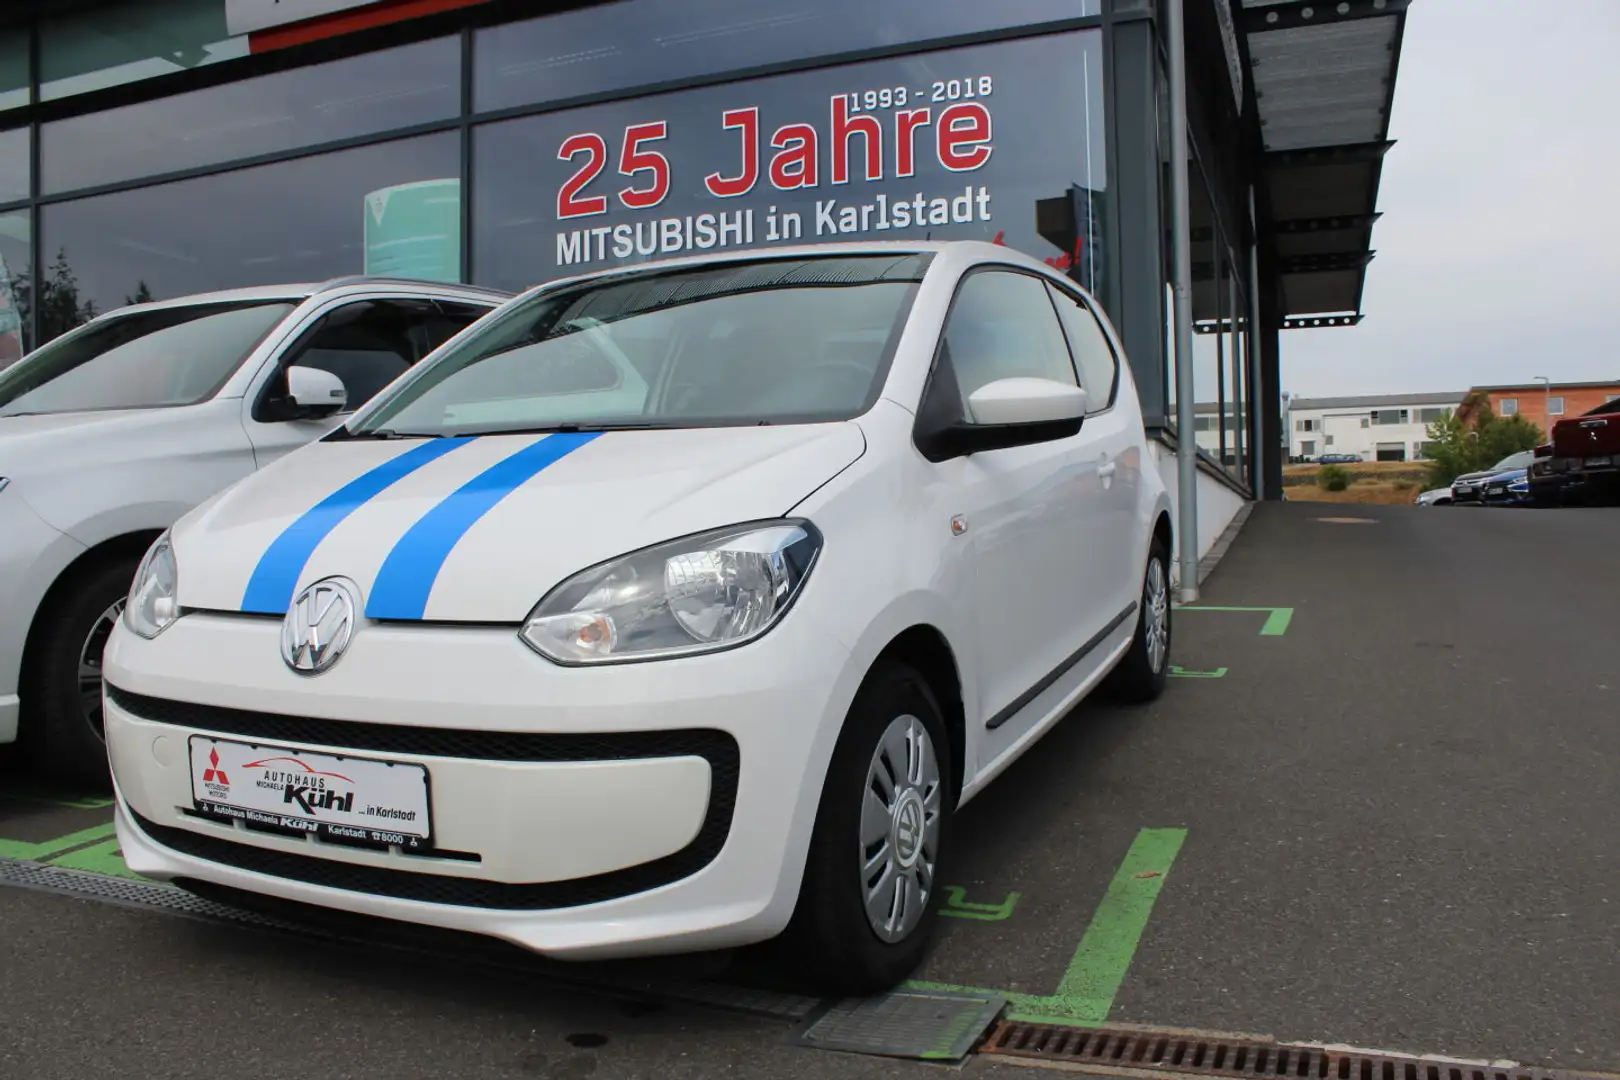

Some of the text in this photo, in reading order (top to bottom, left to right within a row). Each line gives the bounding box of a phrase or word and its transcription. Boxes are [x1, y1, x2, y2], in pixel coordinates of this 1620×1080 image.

[850, 86, 907, 113] 1993
[931, 75, 993, 103] 2018
[556, 94, 994, 220] 25 Jahre
[555, 185, 992, 266] MITSUBISHI in Karlstadt
[264, 770, 326, 789] AUTOHAUS
[256, 780, 355, 816] MICHAELA Kühl
[375, 806, 417, 822] Karlstadt
[213, 804, 246, 819] Autohaus
[246, 809, 279, 826] Michaela
[328, 824, 366, 839] Karlstadt
